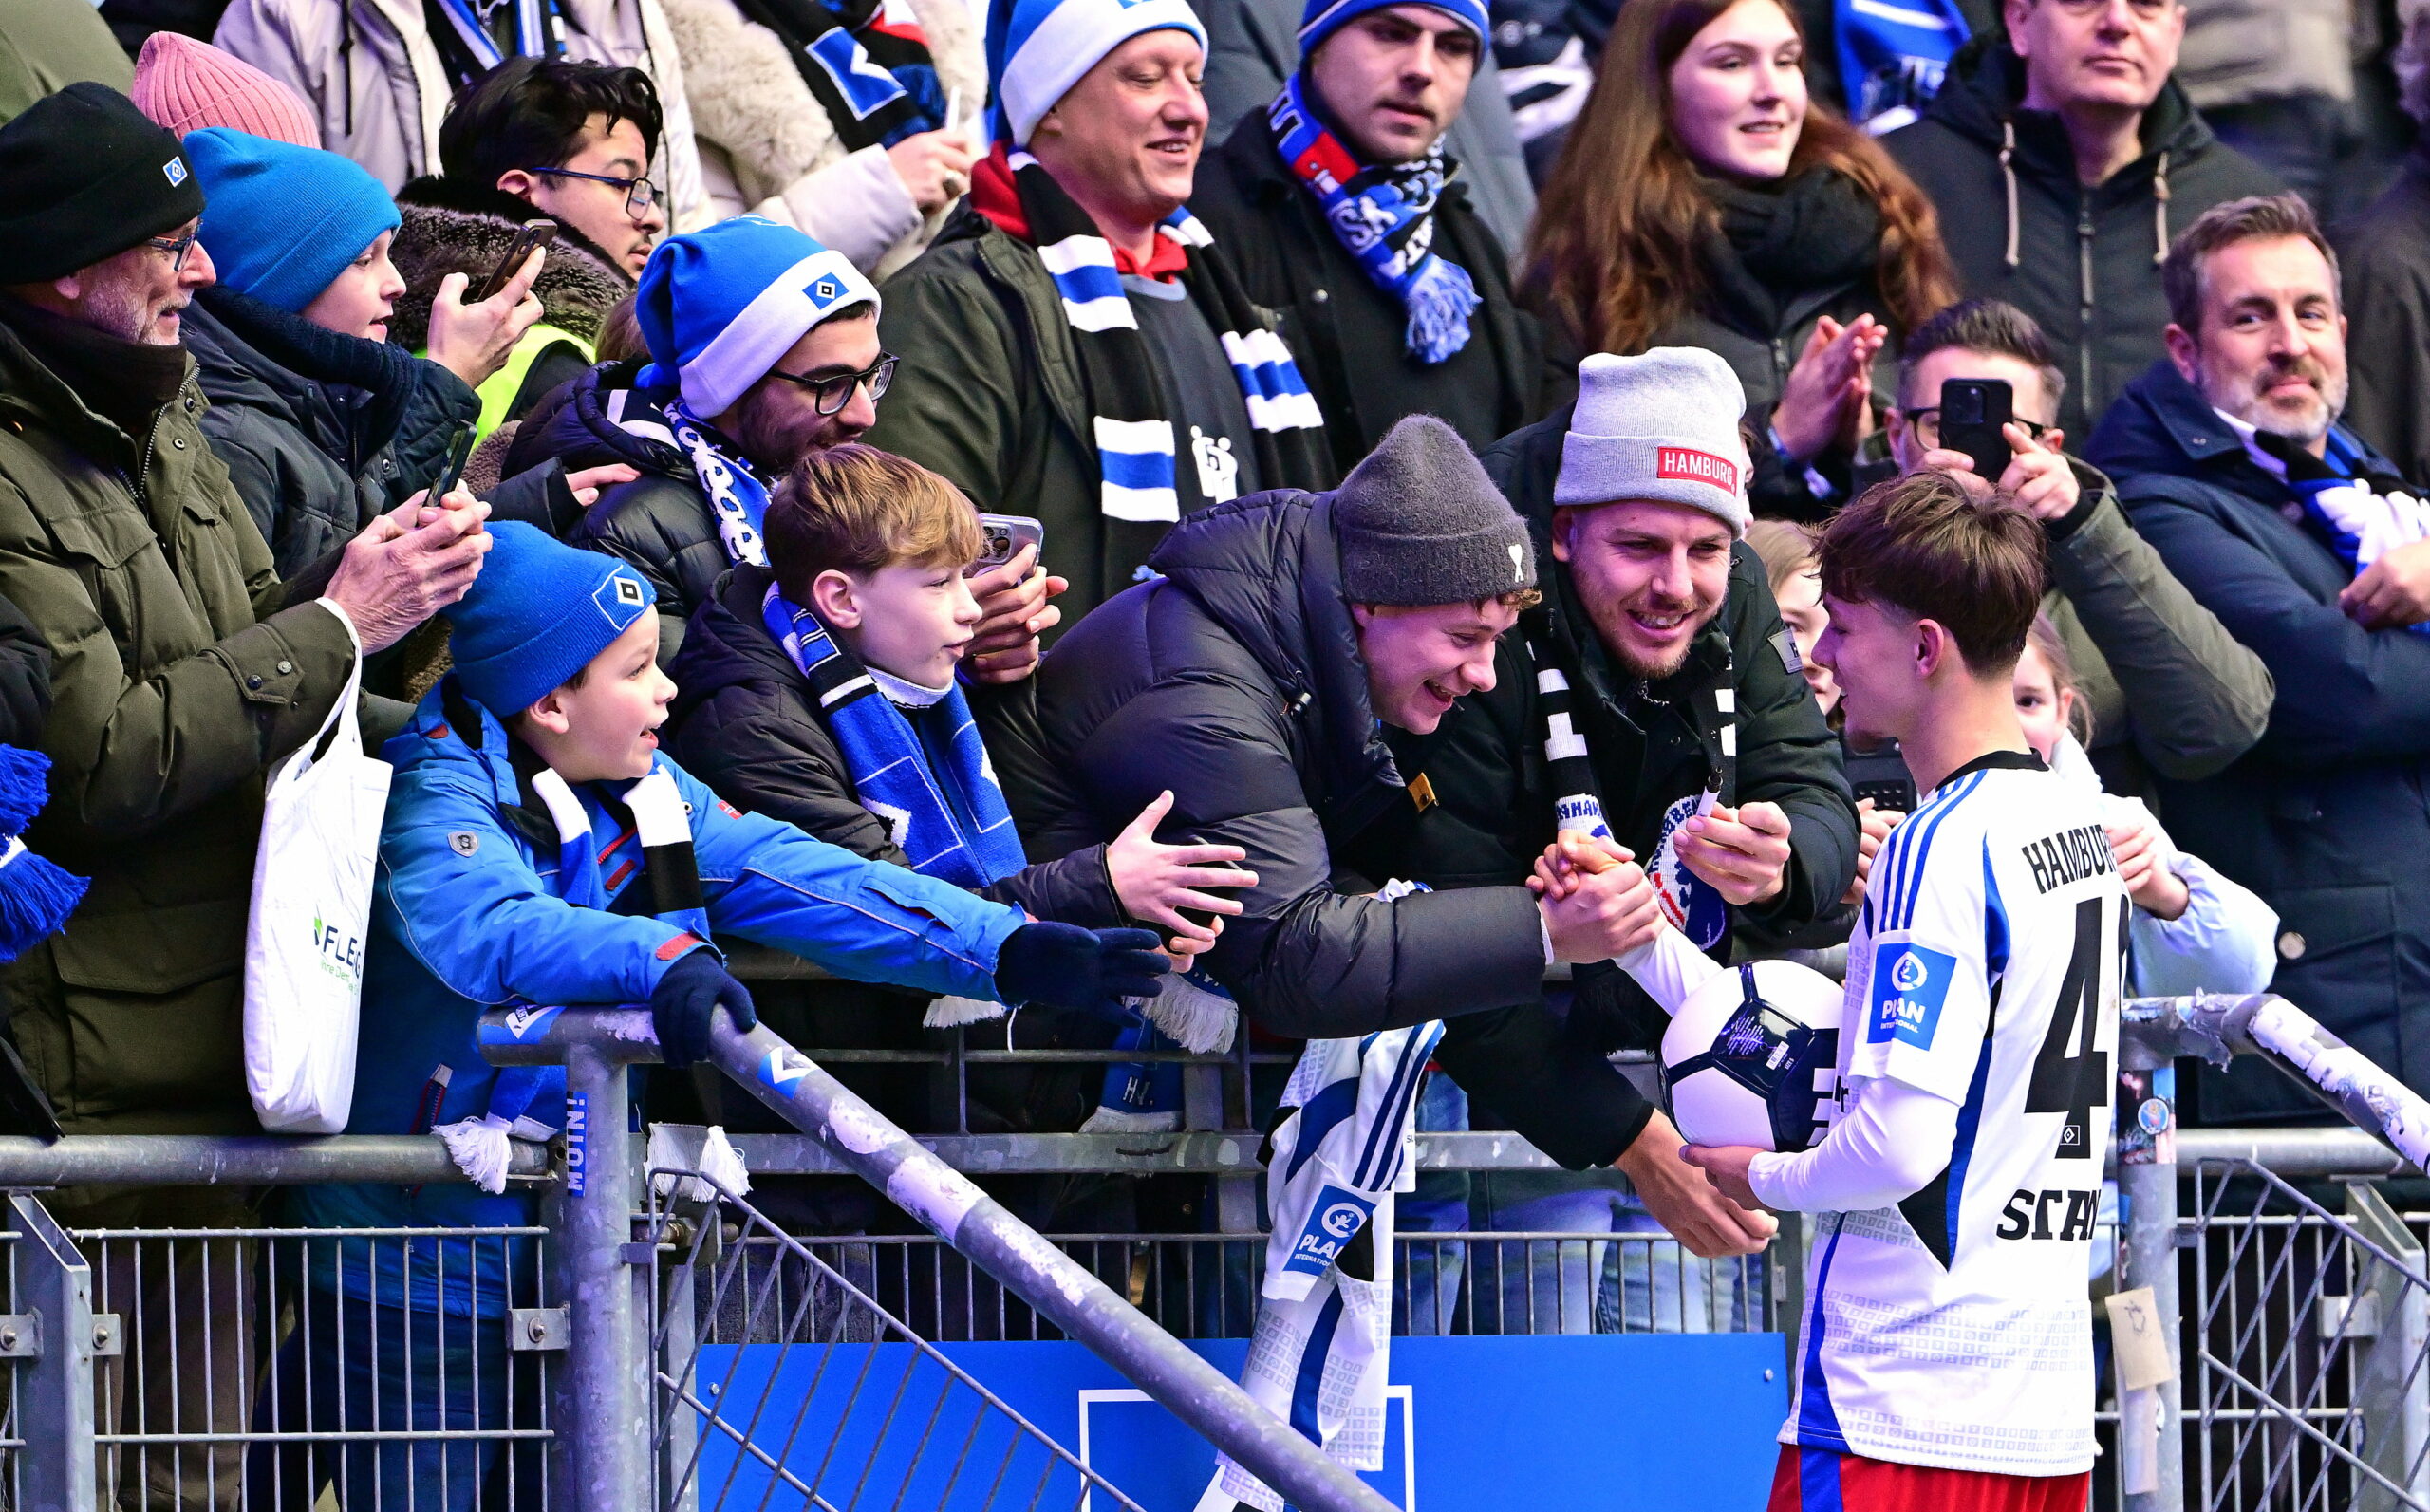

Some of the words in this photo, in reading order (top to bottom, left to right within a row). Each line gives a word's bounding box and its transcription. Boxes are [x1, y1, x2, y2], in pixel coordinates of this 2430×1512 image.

[1665, 452, 1732, 486] HAMBURG
[2021, 824, 2117, 894] HAMBUR
[2024, 896, 2129, 1159] 4
[567, 1098, 586, 1190] MOIN!
